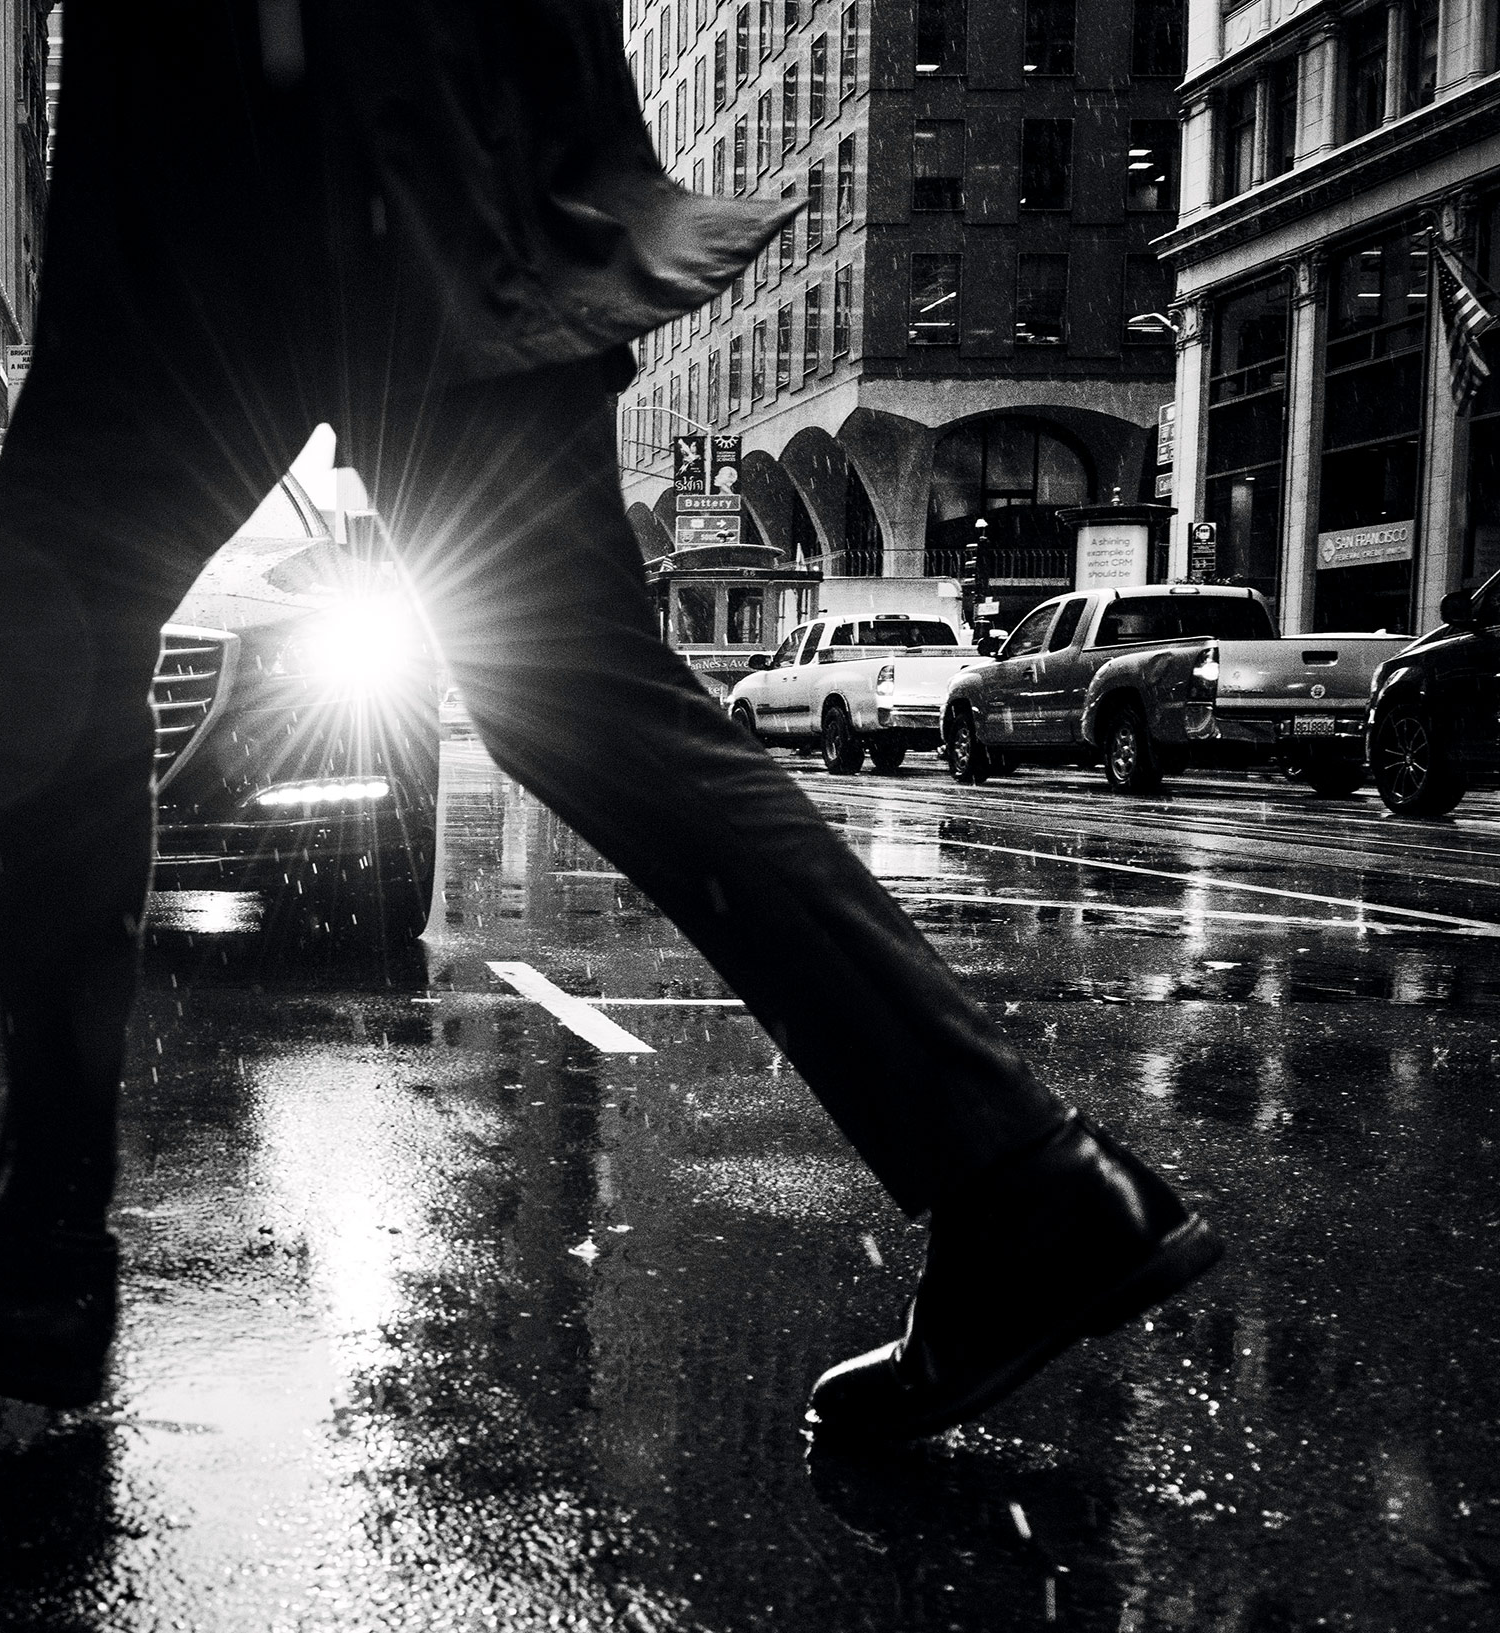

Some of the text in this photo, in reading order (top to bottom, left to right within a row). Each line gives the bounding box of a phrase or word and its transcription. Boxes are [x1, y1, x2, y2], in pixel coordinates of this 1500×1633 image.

[684, 498, 732, 509] Battery
[1091, 537, 1131, 547] A shining
[1335, 527, 1408, 550] SAN FRANCISCO
[1087, 547, 1135, 557] example of
[1088, 558, 1133, 567] what CRM
[1088, 569, 1117, 578] should
